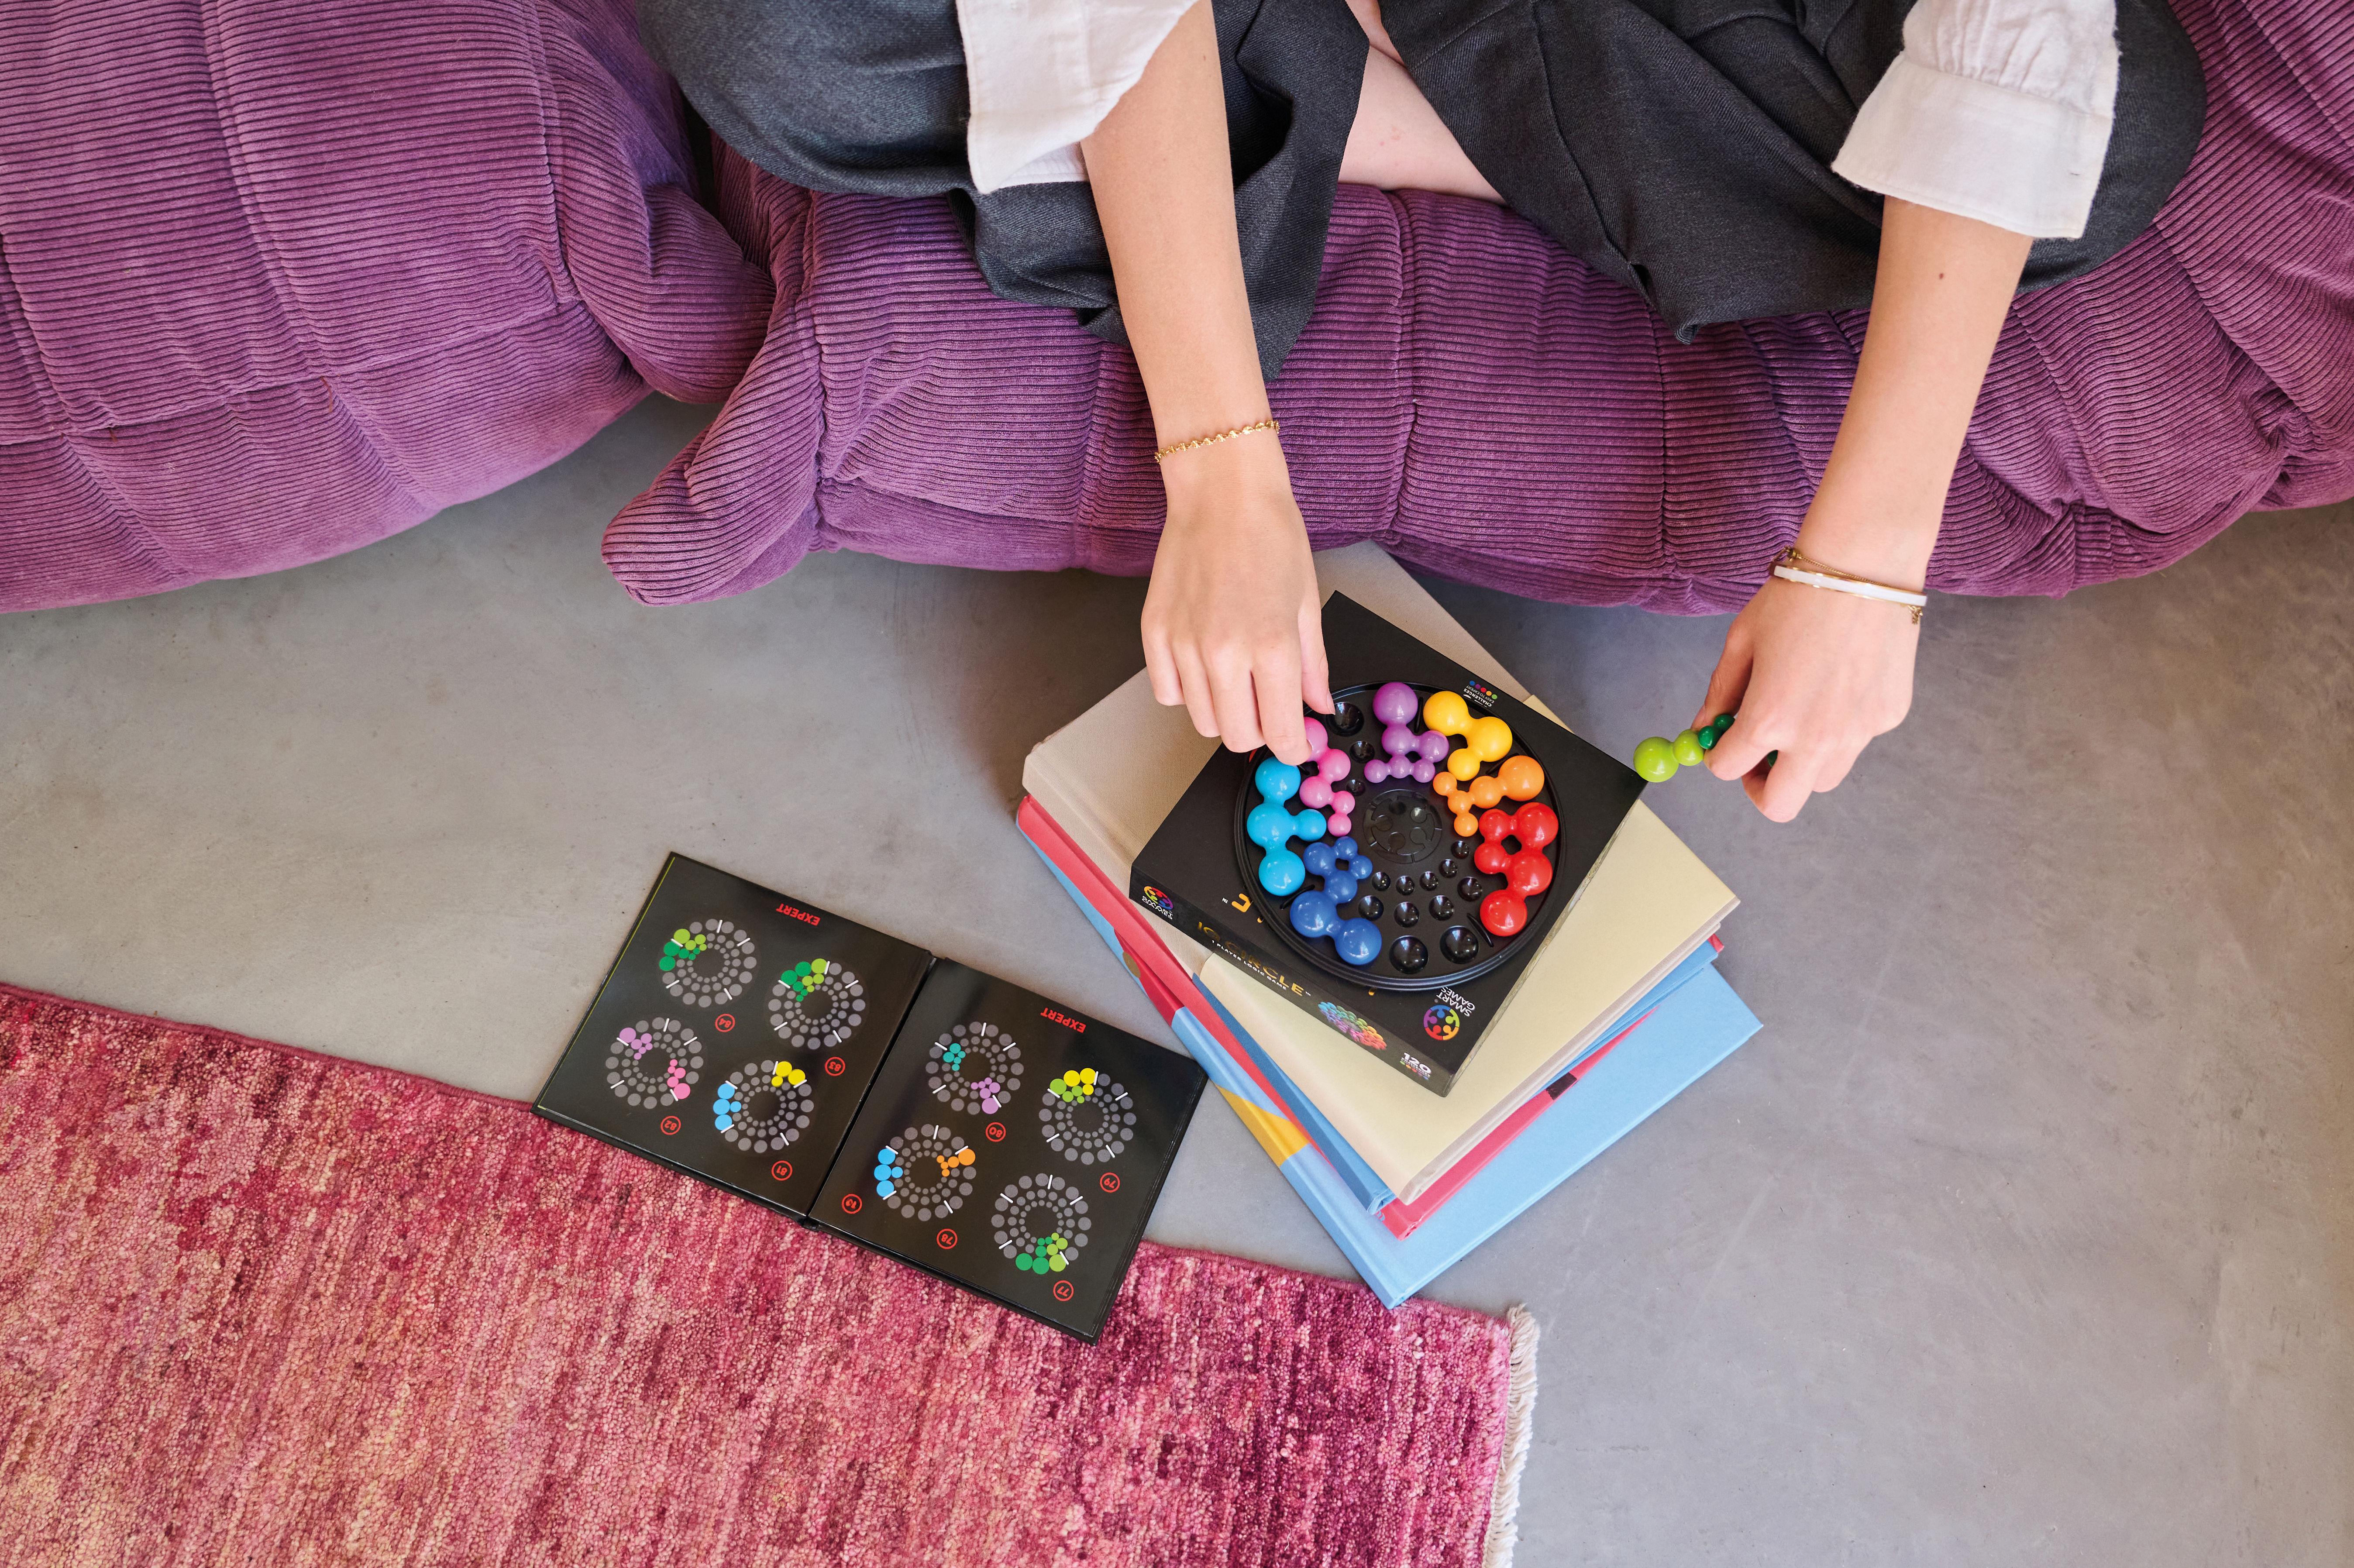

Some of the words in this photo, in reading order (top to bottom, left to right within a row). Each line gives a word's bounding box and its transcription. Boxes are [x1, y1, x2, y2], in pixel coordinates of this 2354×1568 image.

[1466, 685, 1480, 695] EXPERT
[1463, 688, 1492, 707] CHALLENGES
[776, 903, 821, 926] EXPERT
[1198, 922, 1221, 942] IQ
[1217, 943, 1242, 961] PLAYER
[1243, 960, 1265, 976] LOGIC
[1266, 976, 1287, 990] GAME
[1436, 992, 1472, 1017] SMART
[1441, 986, 1476, 1011] GAMES
[719, 1018, 732, 1028] 84
[1040, 1008, 1086, 1033] EXPERT
[828, 1061, 842, 1072] 83
[1404, 1052, 1432, 1074] 120
[664, 1120, 678, 1131] 82
[989, 1126, 1003, 1138] 80
[776, 1165, 788, 1176] 81
[1104, 1177, 1116, 1189] 79
[941, 1233, 953, 1245] 78
[1057, 1286, 1070, 1297] 77
